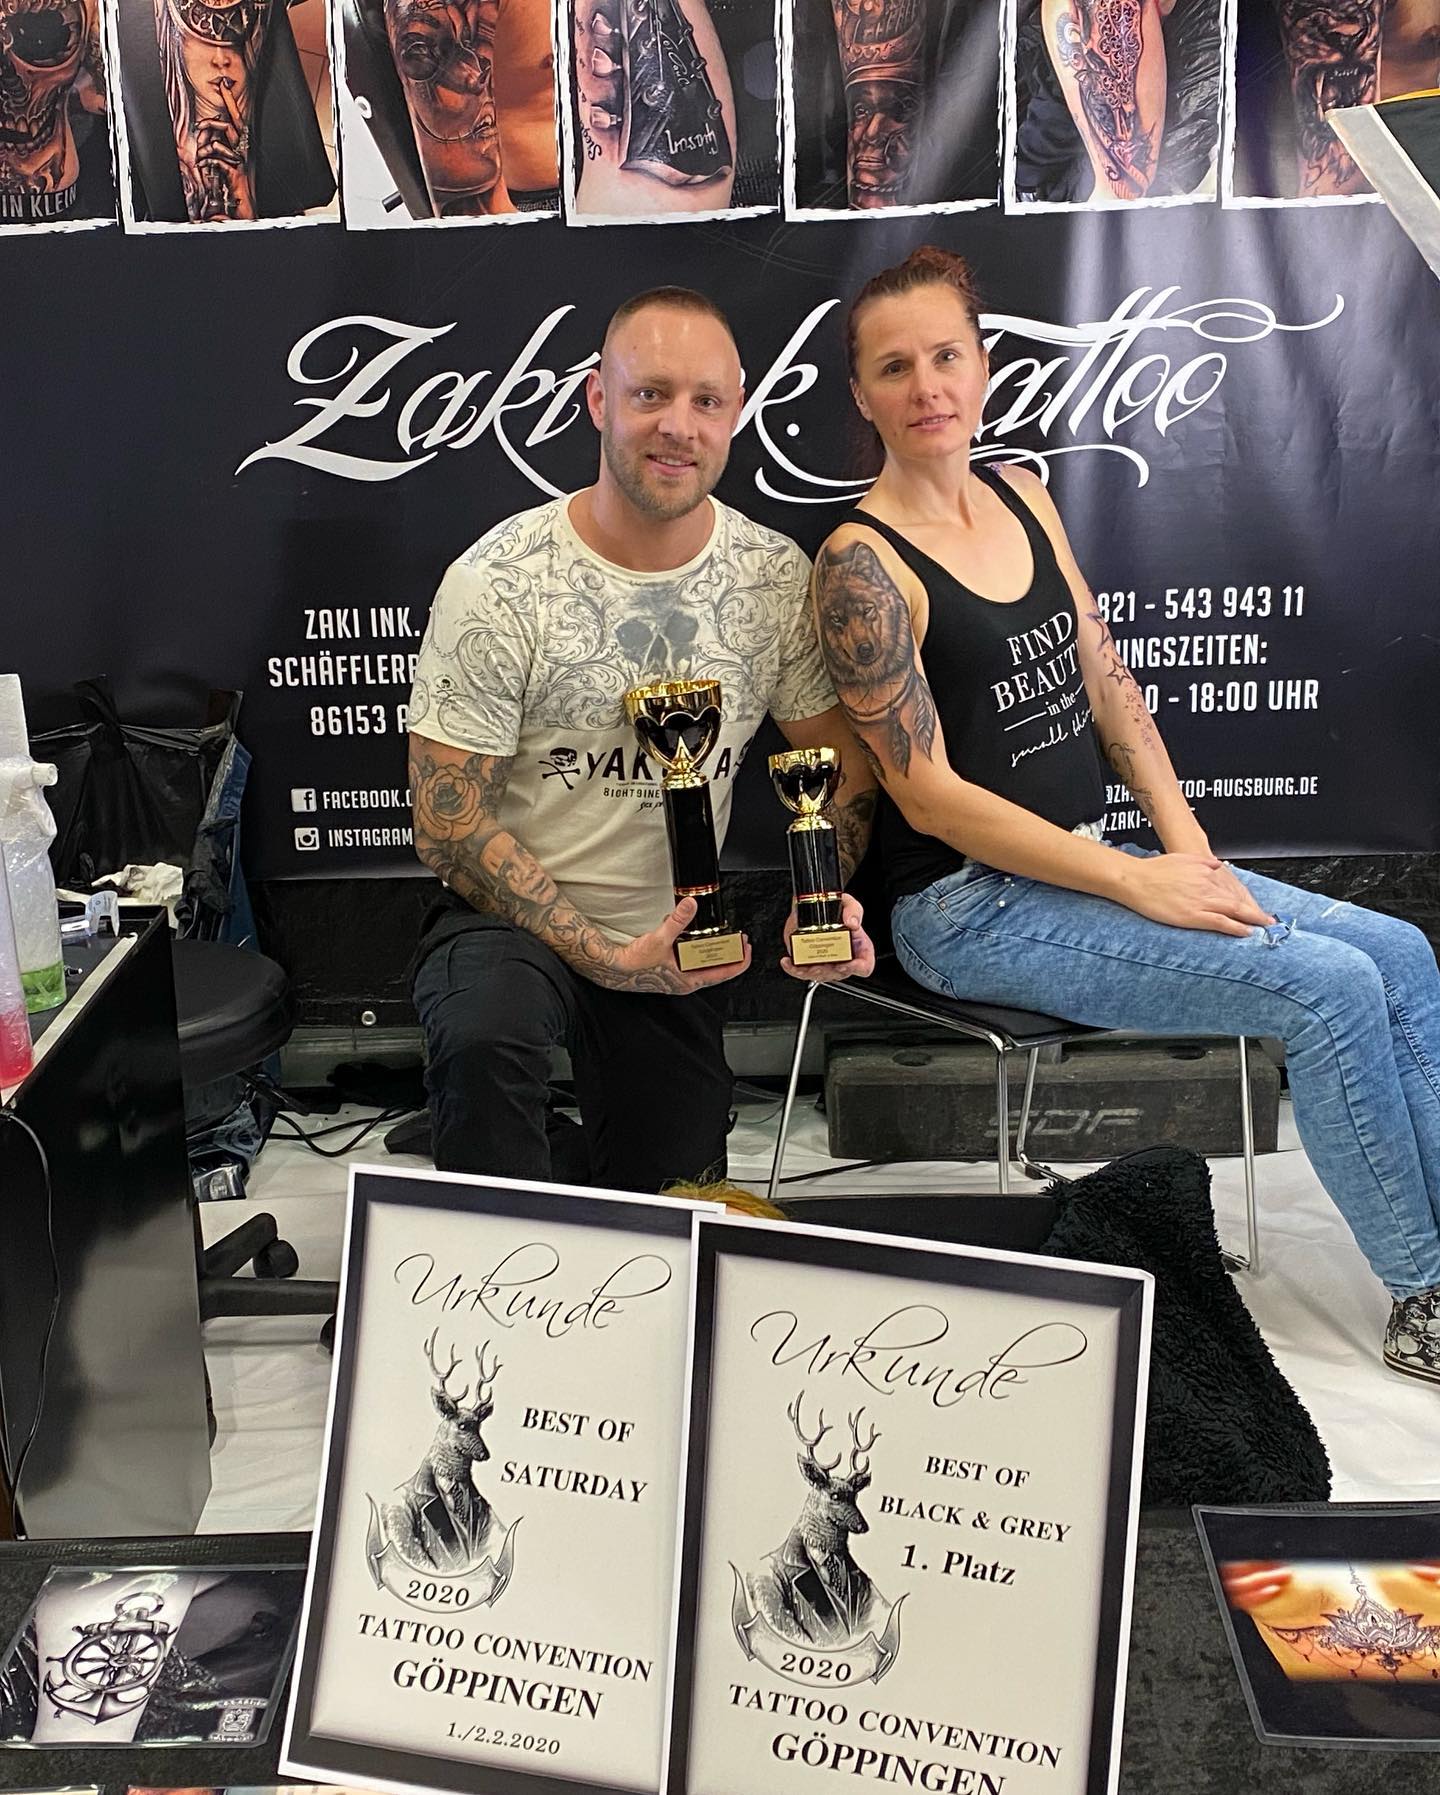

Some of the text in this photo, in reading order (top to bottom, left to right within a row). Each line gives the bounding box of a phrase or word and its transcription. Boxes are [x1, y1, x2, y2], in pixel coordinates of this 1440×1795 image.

[31, 183, 77, 217] KLEIN
[235, 304, 602, 498] Zaki
[1165, 588, 1212, 619] 543
[1223, 586, 1272, 618] 943
[1283, 586, 1304, 617] 11
[304, 607, 421, 639] ZAKI INK.
[1006, 611, 1073, 666] FIND
[990, 640, 1078, 713] BEAUT
[1189, 681, 1258, 713] 18:00
[1269, 679, 1319, 710] UHR
[310, 705, 387, 736] 86153
[1045, 693, 1076, 716] in the
[587, 746, 732, 781] YAKA
[1011, 723, 1069, 768] small
[328, 828, 413, 847] INSTAGRAM
[394, 1242, 672, 1338] Urkunde
[750, 1304, 1088, 1408] Urkunde
[521, 1407, 635, 1443] BEST OF
[500, 1461, 648, 1503] SATURDAY
[925, 1456, 1030, 1488] BEST OF
[879, 1495, 1072, 1543] BLACK & GREY
[901, 1544, 1016, 1586] 1. Platz
[406, 1580, 469, 1606] 2020
[358, 1614, 654, 1683] TATTOO CONVENTION
[780, 1653, 852, 1682] 2020
[393, 1657, 604, 1720] GÖPPINGEN
[446, 1722, 561, 1756] 1./2.2.2020
[729, 1684, 1063, 1769] TATTOO CONVENTION
[771, 1731, 1007, 1795] GÖPPINGEN
